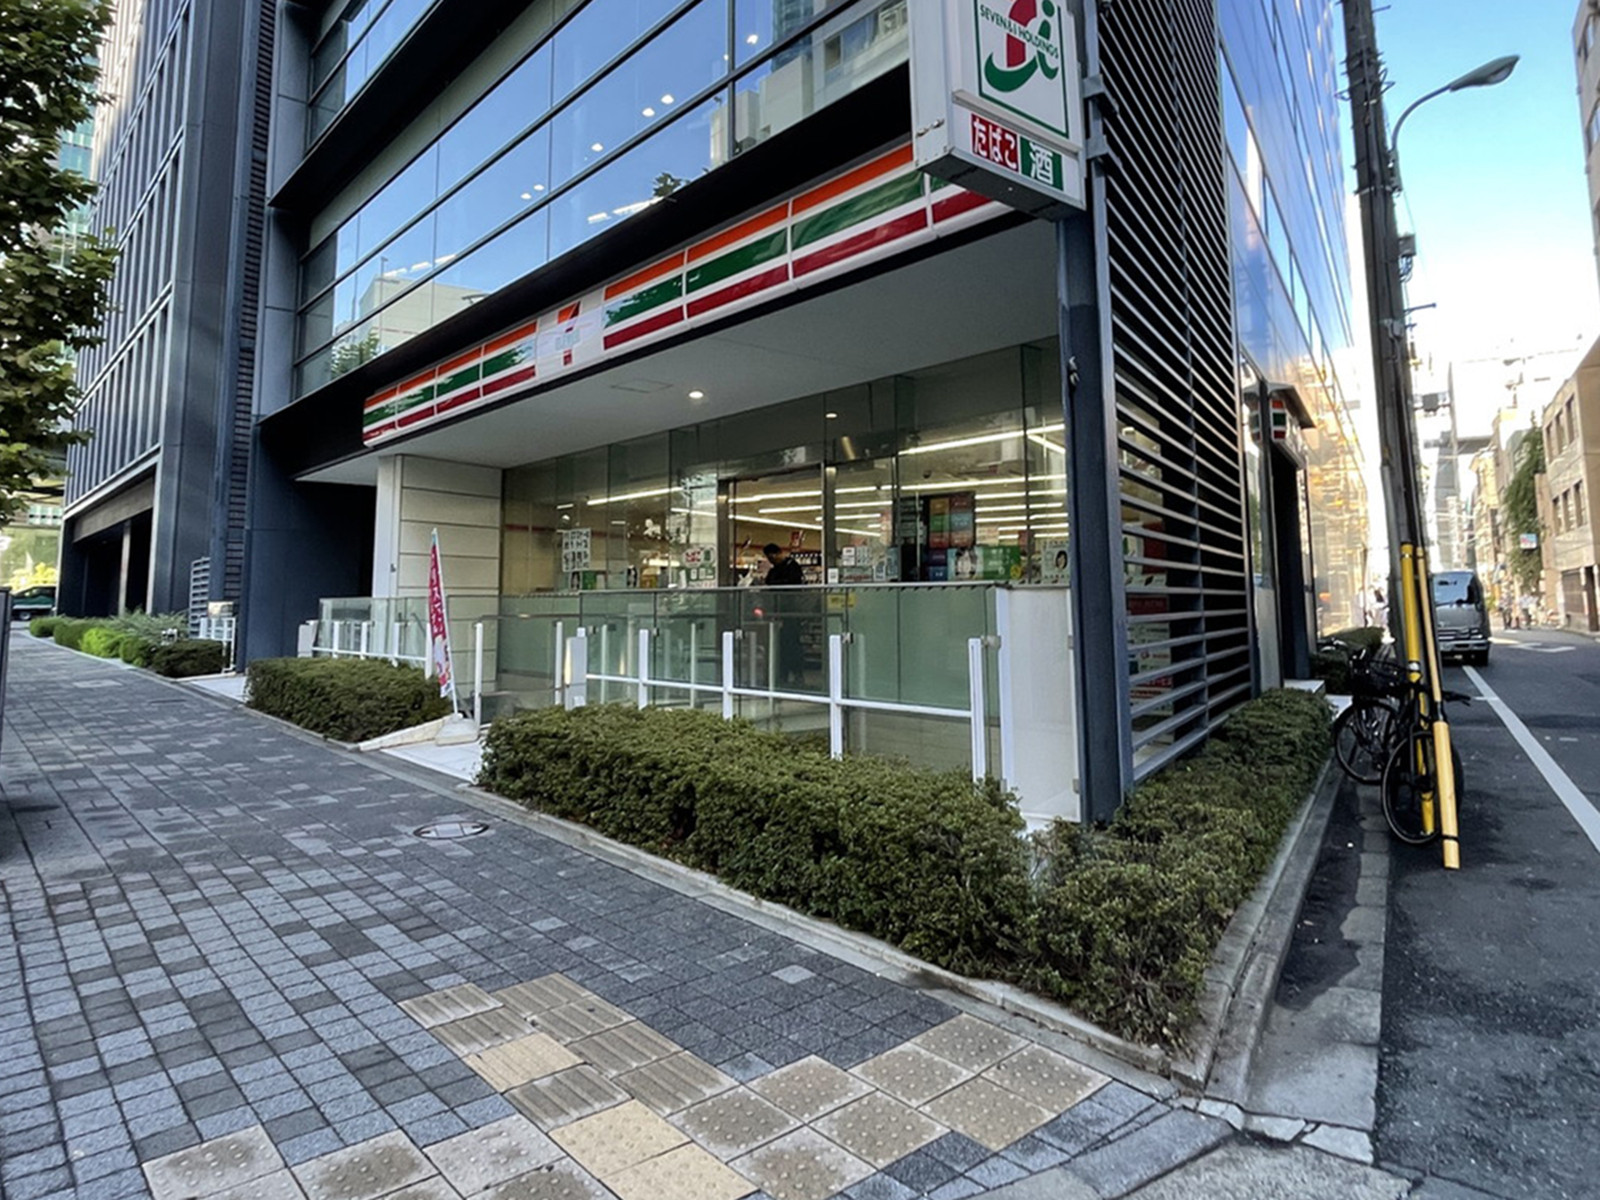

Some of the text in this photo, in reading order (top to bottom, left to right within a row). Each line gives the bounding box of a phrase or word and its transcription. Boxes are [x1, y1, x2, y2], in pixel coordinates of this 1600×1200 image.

[974, 118, 1017, 169] たばこ
[1029, 141, 1053, 185] 酒
